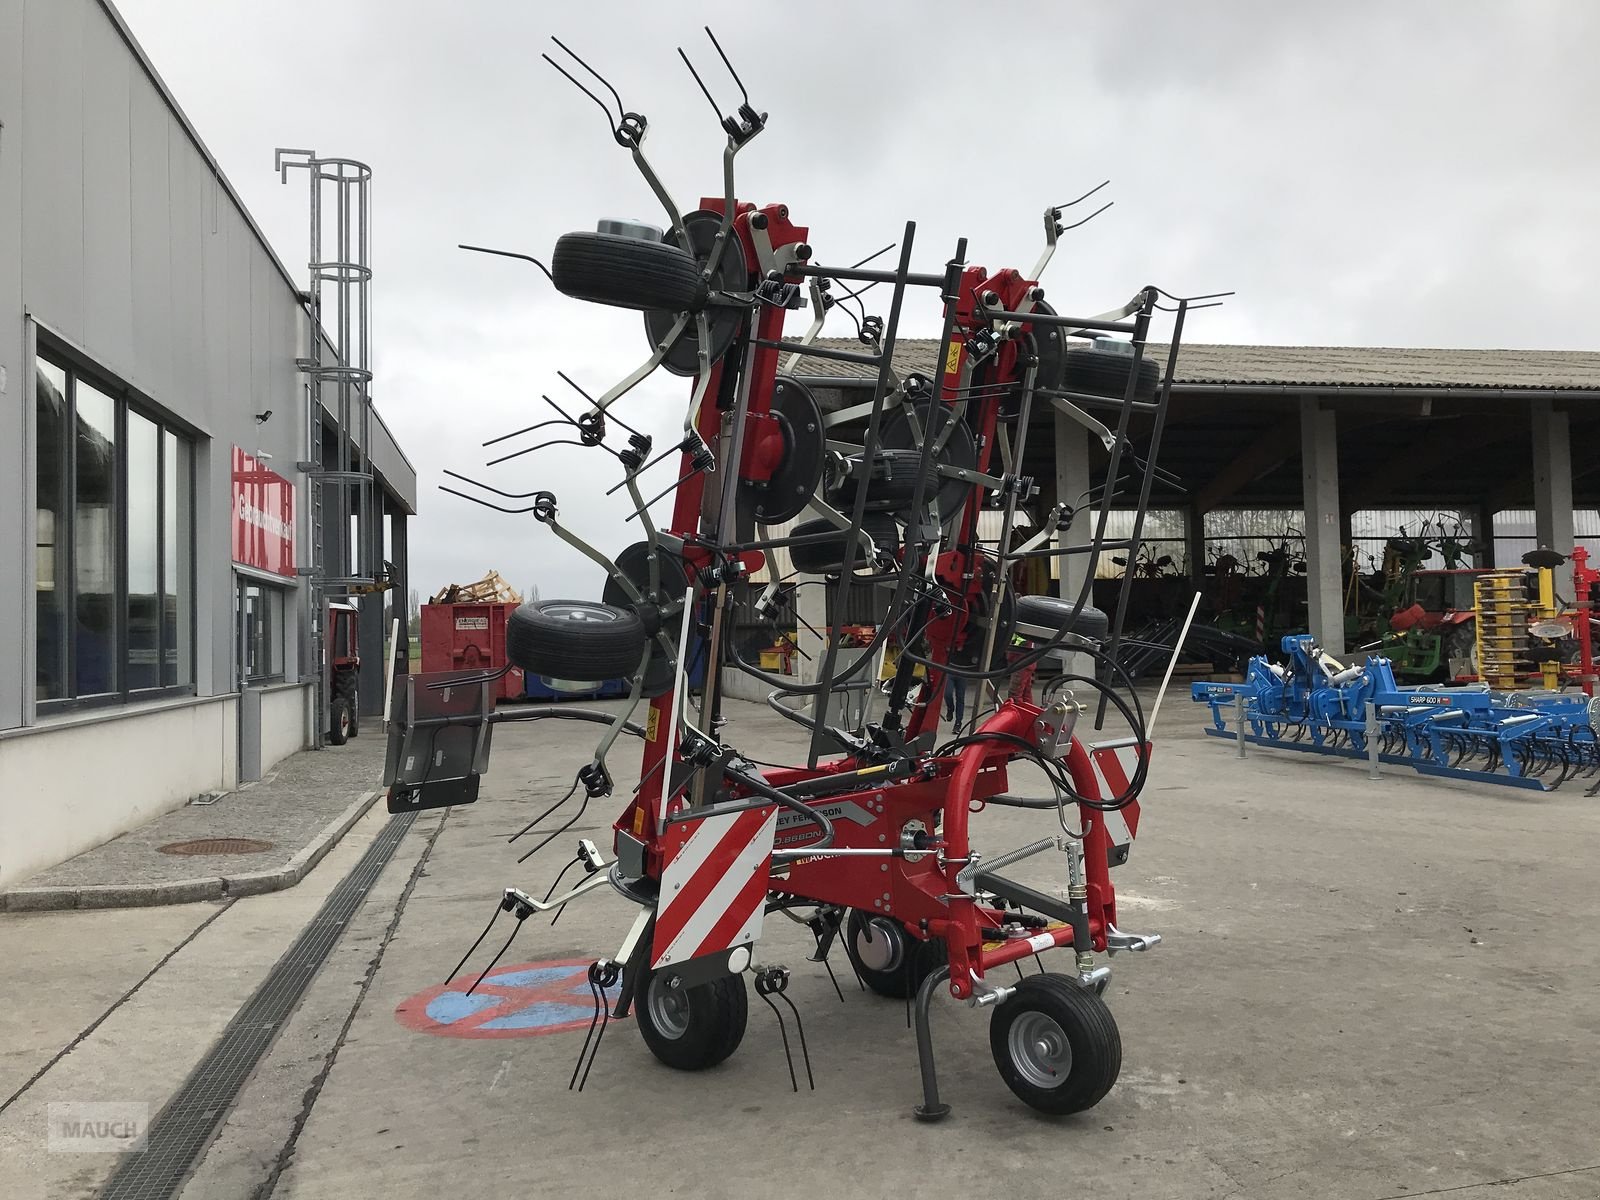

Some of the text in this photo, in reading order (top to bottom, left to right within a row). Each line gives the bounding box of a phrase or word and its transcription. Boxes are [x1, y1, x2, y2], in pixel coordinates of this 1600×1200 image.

[1410, 696, 1426, 704] SHARP
[1426, 696, 1437, 704] 600
[792, 807, 842, 823] FERSON
